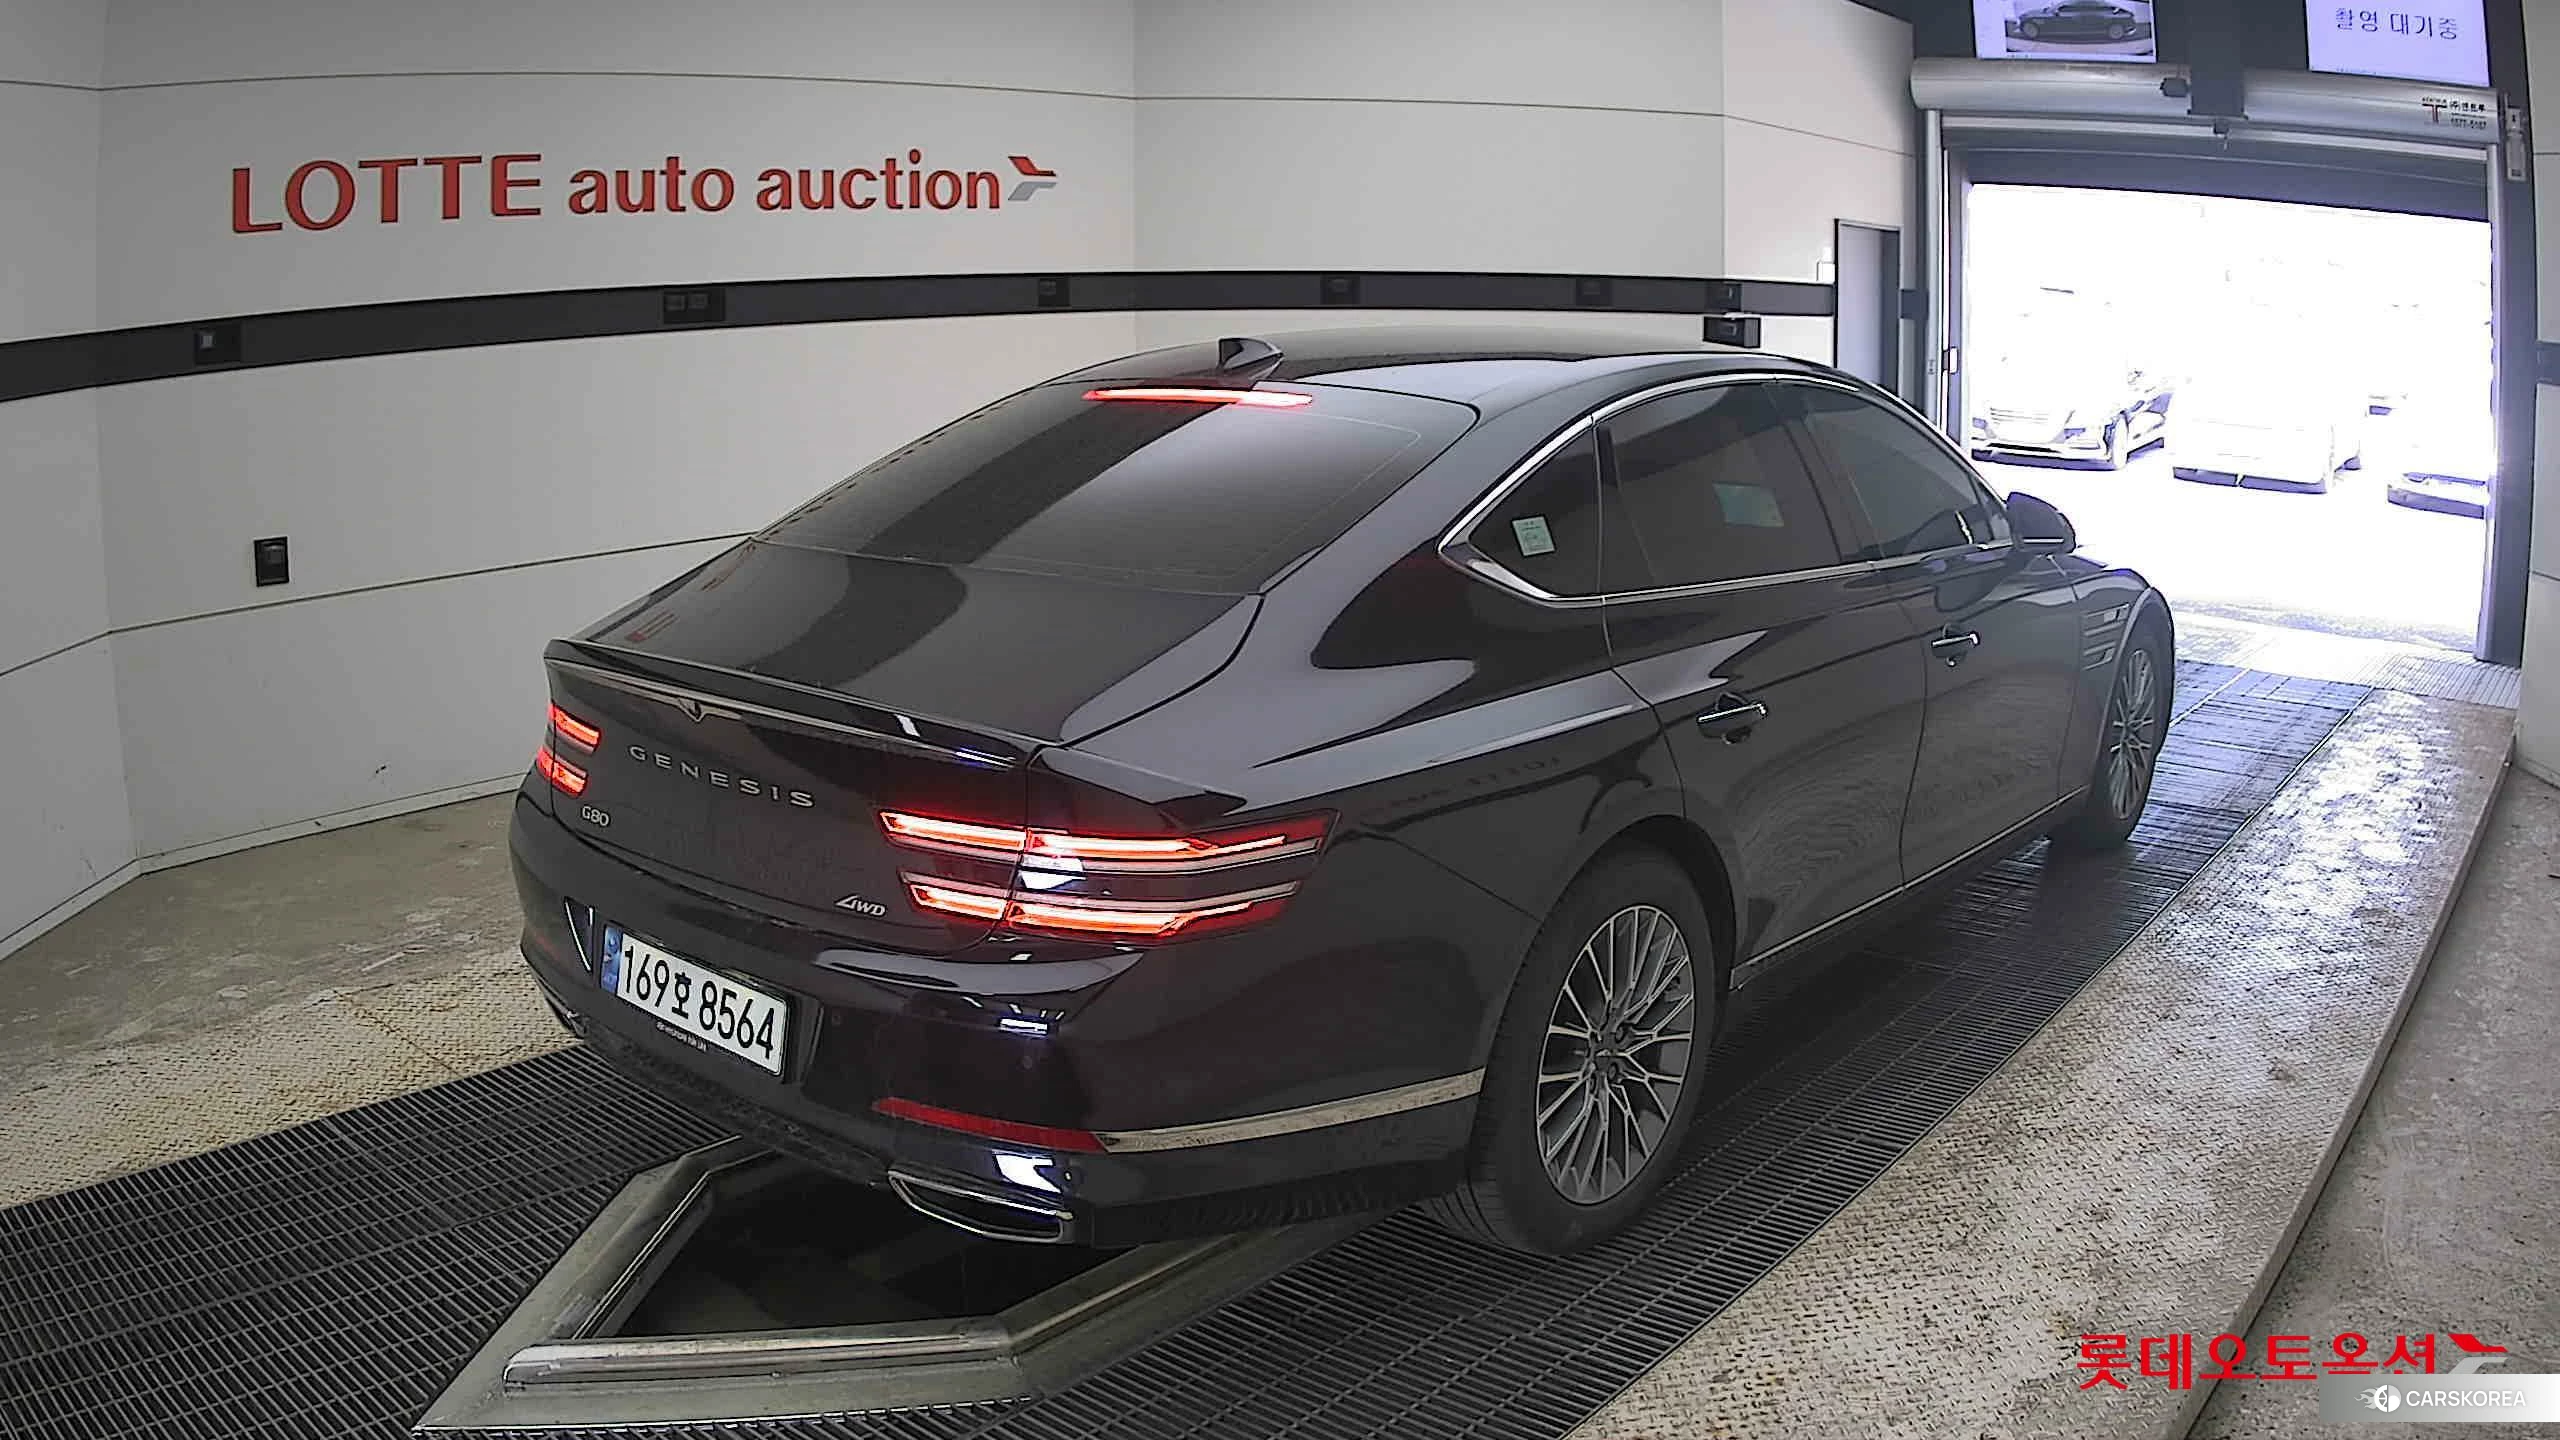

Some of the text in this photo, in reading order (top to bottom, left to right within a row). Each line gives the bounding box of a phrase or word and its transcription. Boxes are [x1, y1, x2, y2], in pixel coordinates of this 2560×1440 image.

[2336, 8, 2457, 40] 촬영 대기중
[232, 149, 1001, 233] LOTTE auto auction
[629, 745, 815, 807] GENESIS
[581, 805, 610, 828] G80
[834, 895, 886, 917] 4WD
[624, 945, 692, 1020] 169호
[699, 980, 775, 1060] 8564
